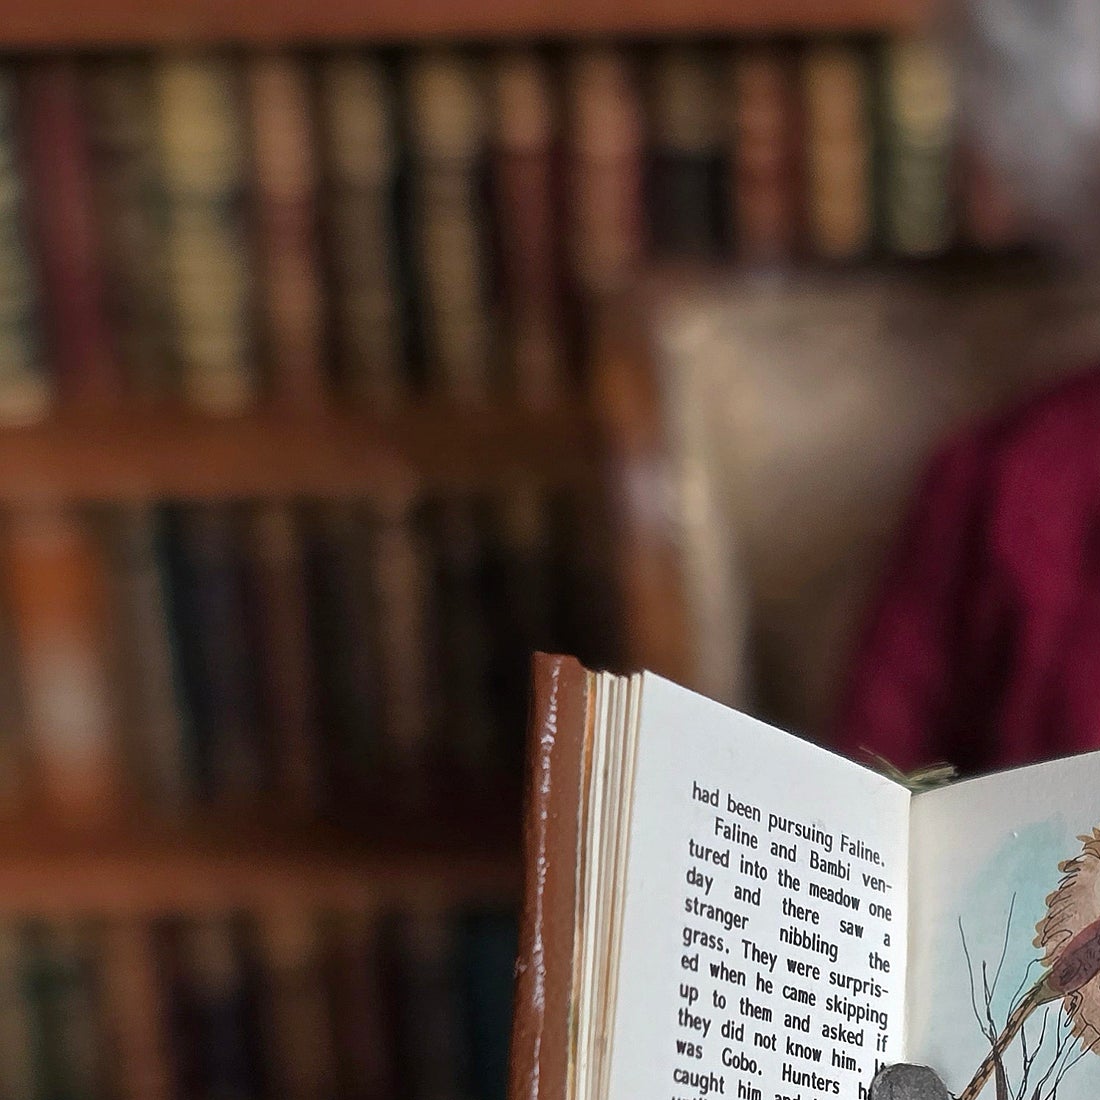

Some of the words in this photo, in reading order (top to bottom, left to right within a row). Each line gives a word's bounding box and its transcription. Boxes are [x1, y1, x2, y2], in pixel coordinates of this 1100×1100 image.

[692, 781, 720, 807] had
[727, 793, 761, 822] been
[768, 813, 834, 852] pursuing
[840, 834, 886, 867] Faline.
[715, 817, 758, 849] Faline
[770, 841, 797, 862] and
[810, 851, 852, 881] Bambi
[862, 872, 893, 893] ven-
[686, 867, 714, 895] day
[734, 883, 761, 906] and
[782, 898, 820, 925] there
[839, 919, 864, 939] saw
[883, 932, 891, 947] a
[688, 838, 730, 868] tured
[739, 854, 768, 881] into
[778, 869, 801, 892] the
[809, 882, 861, 911] meadow
[868, 902, 892, 922] one
[682, 927, 730, 954] grass.
[742, 940, 778, 973] They
[787, 958, 820, 980] were
[829, 971, 889, 998] surpris-
[684, 897, 750, 931] stranger
[779, 926, 839, 962] nibbling
[868, 952, 891, 973] the
[679, 982, 699, 1006] up
[712, 990, 727, 1010] to
[739, 997, 773, 1023] them
[784, 1012, 811, 1033] and
[821, 1022, 864, 1047] asked
[876, 1033, 888, 1053] if
[681, 954, 699, 972] ed
[709, 961, 747, 987] when
[756, 973, 773, 995] he
[782, 984, 817, 1007] came
[825, 994, 889, 1030] skipping
[676, 1038, 703, 1060] was
[721, 1047, 763, 1076] Gobo.
[782, 1063, 841, 1095] Hunters
[678, 1008, 712, 1038] they
[721, 1020, 745, 1042] did
[753, 1031, 777, 1052] not
[785, 1036, 822, 1063] know
[832, 1048, 862, 1073] him.
[673, 1067, 726, 1095] caught
